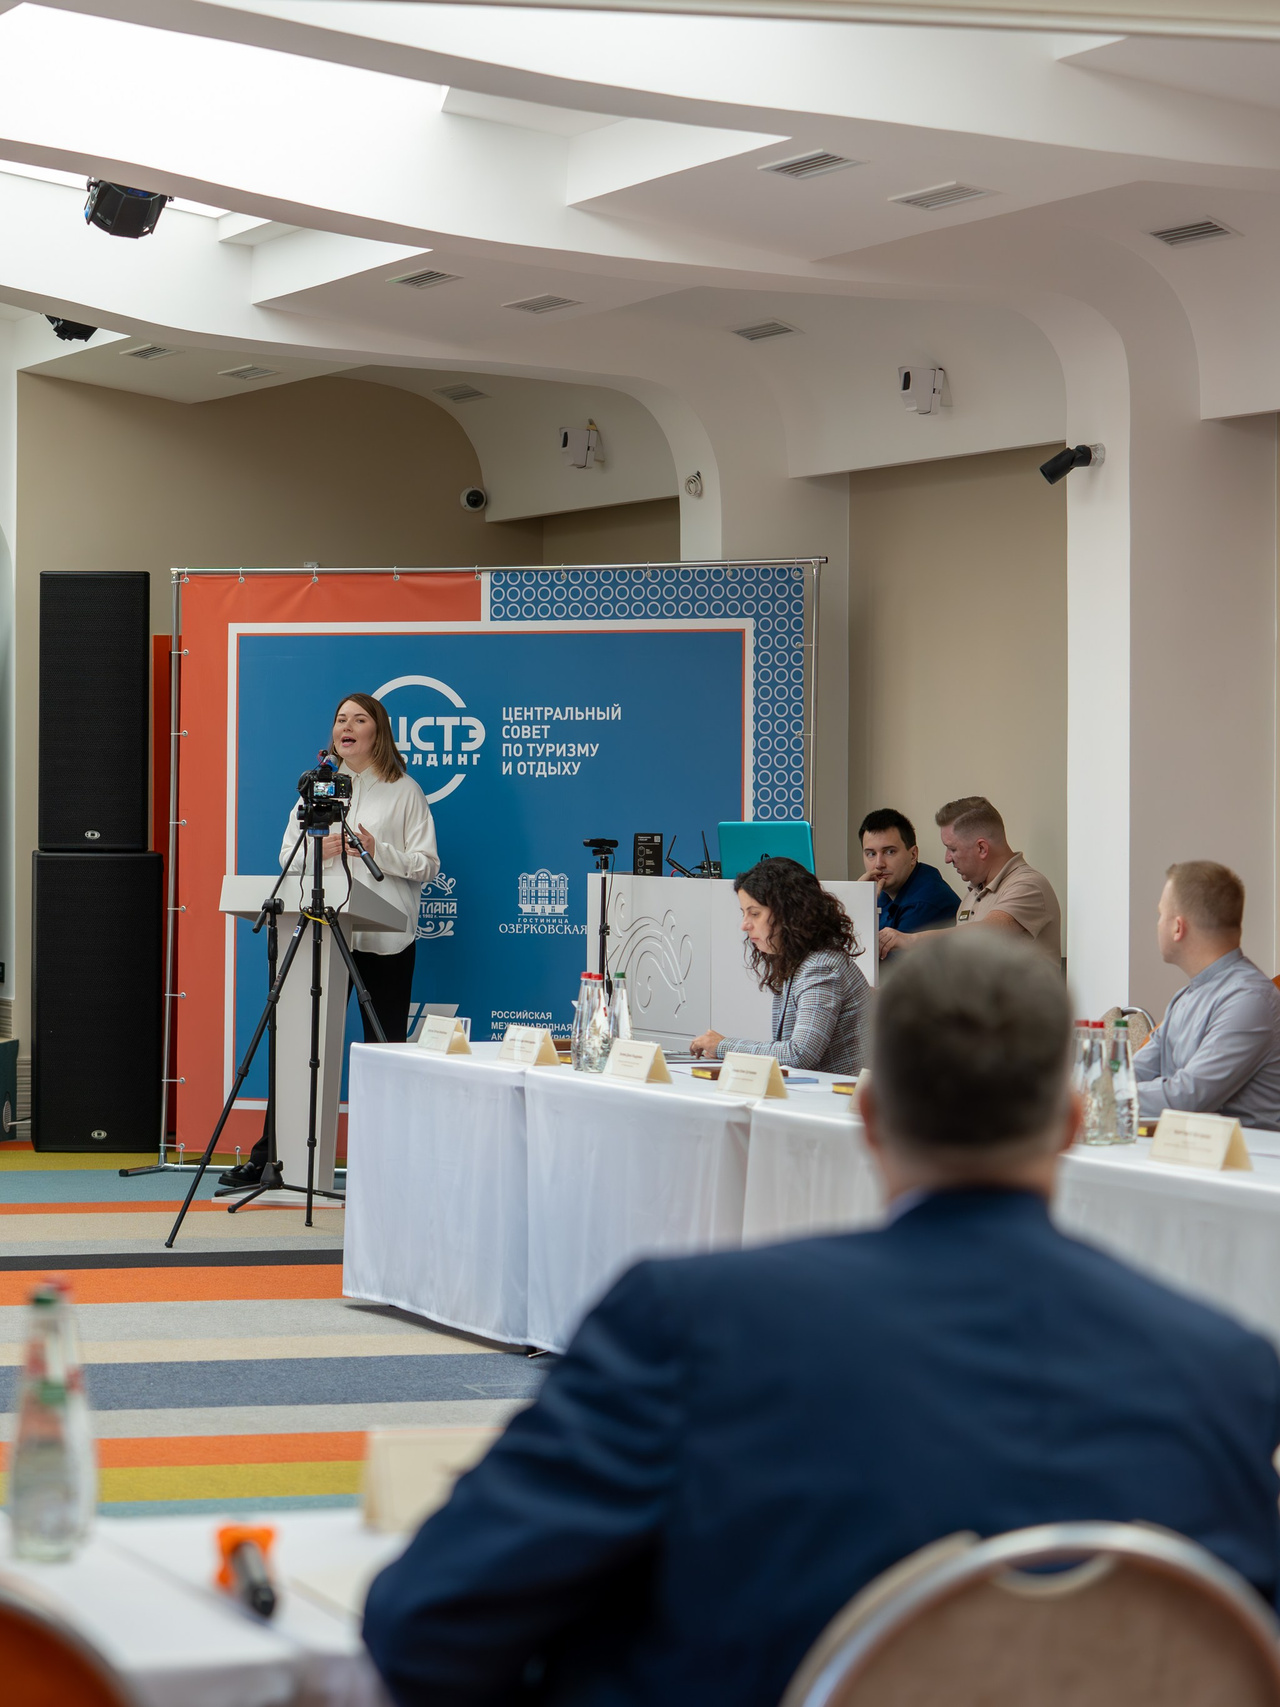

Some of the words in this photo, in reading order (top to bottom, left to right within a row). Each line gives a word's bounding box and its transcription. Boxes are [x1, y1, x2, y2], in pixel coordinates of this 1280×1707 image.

[502, 703, 622, 724] ЦЕНТРАЛЬНЫЙ
[502, 725, 550, 739] СОВЕТ
[502, 743, 523, 757] ПО
[526, 743, 599, 757] ТУРИЗМУ
[502, 762, 513, 775] И
[517, 761, 581, 778] ОТДЫХУ
[420, 902, 457, 914] ТЛАНА
[499, 923, 587, 935] ОЗЕРКОВСКАЯ
[491, 1010, 552, 1020] РОССИЙСКАЯ
